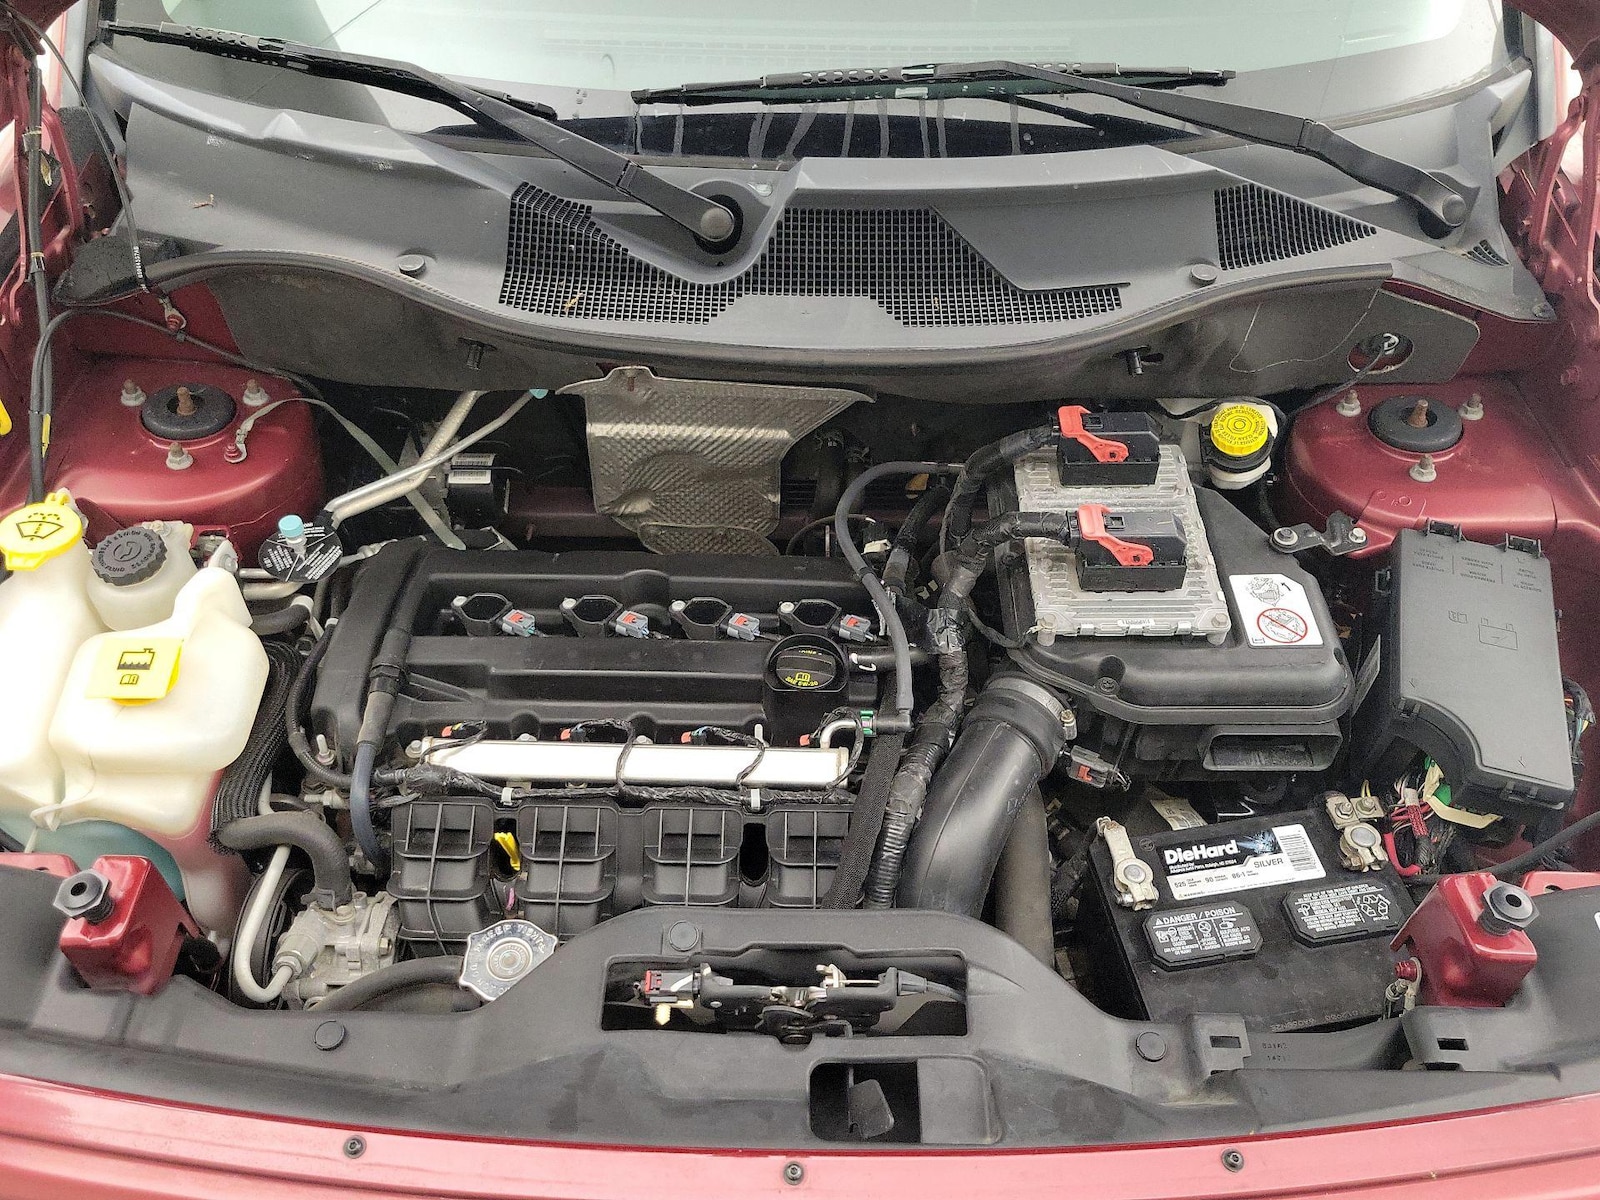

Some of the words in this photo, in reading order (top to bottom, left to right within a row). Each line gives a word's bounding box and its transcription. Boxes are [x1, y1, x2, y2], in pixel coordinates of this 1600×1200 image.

[1164, 840, 1240, 865] DieHard
[1254, 858, 1283, 868] SILVER
[1163, 913, 1197, 924] DANGER
[1204, 906, 1236, 918] POISON
[518, 925, 544, 944] TIGHT
